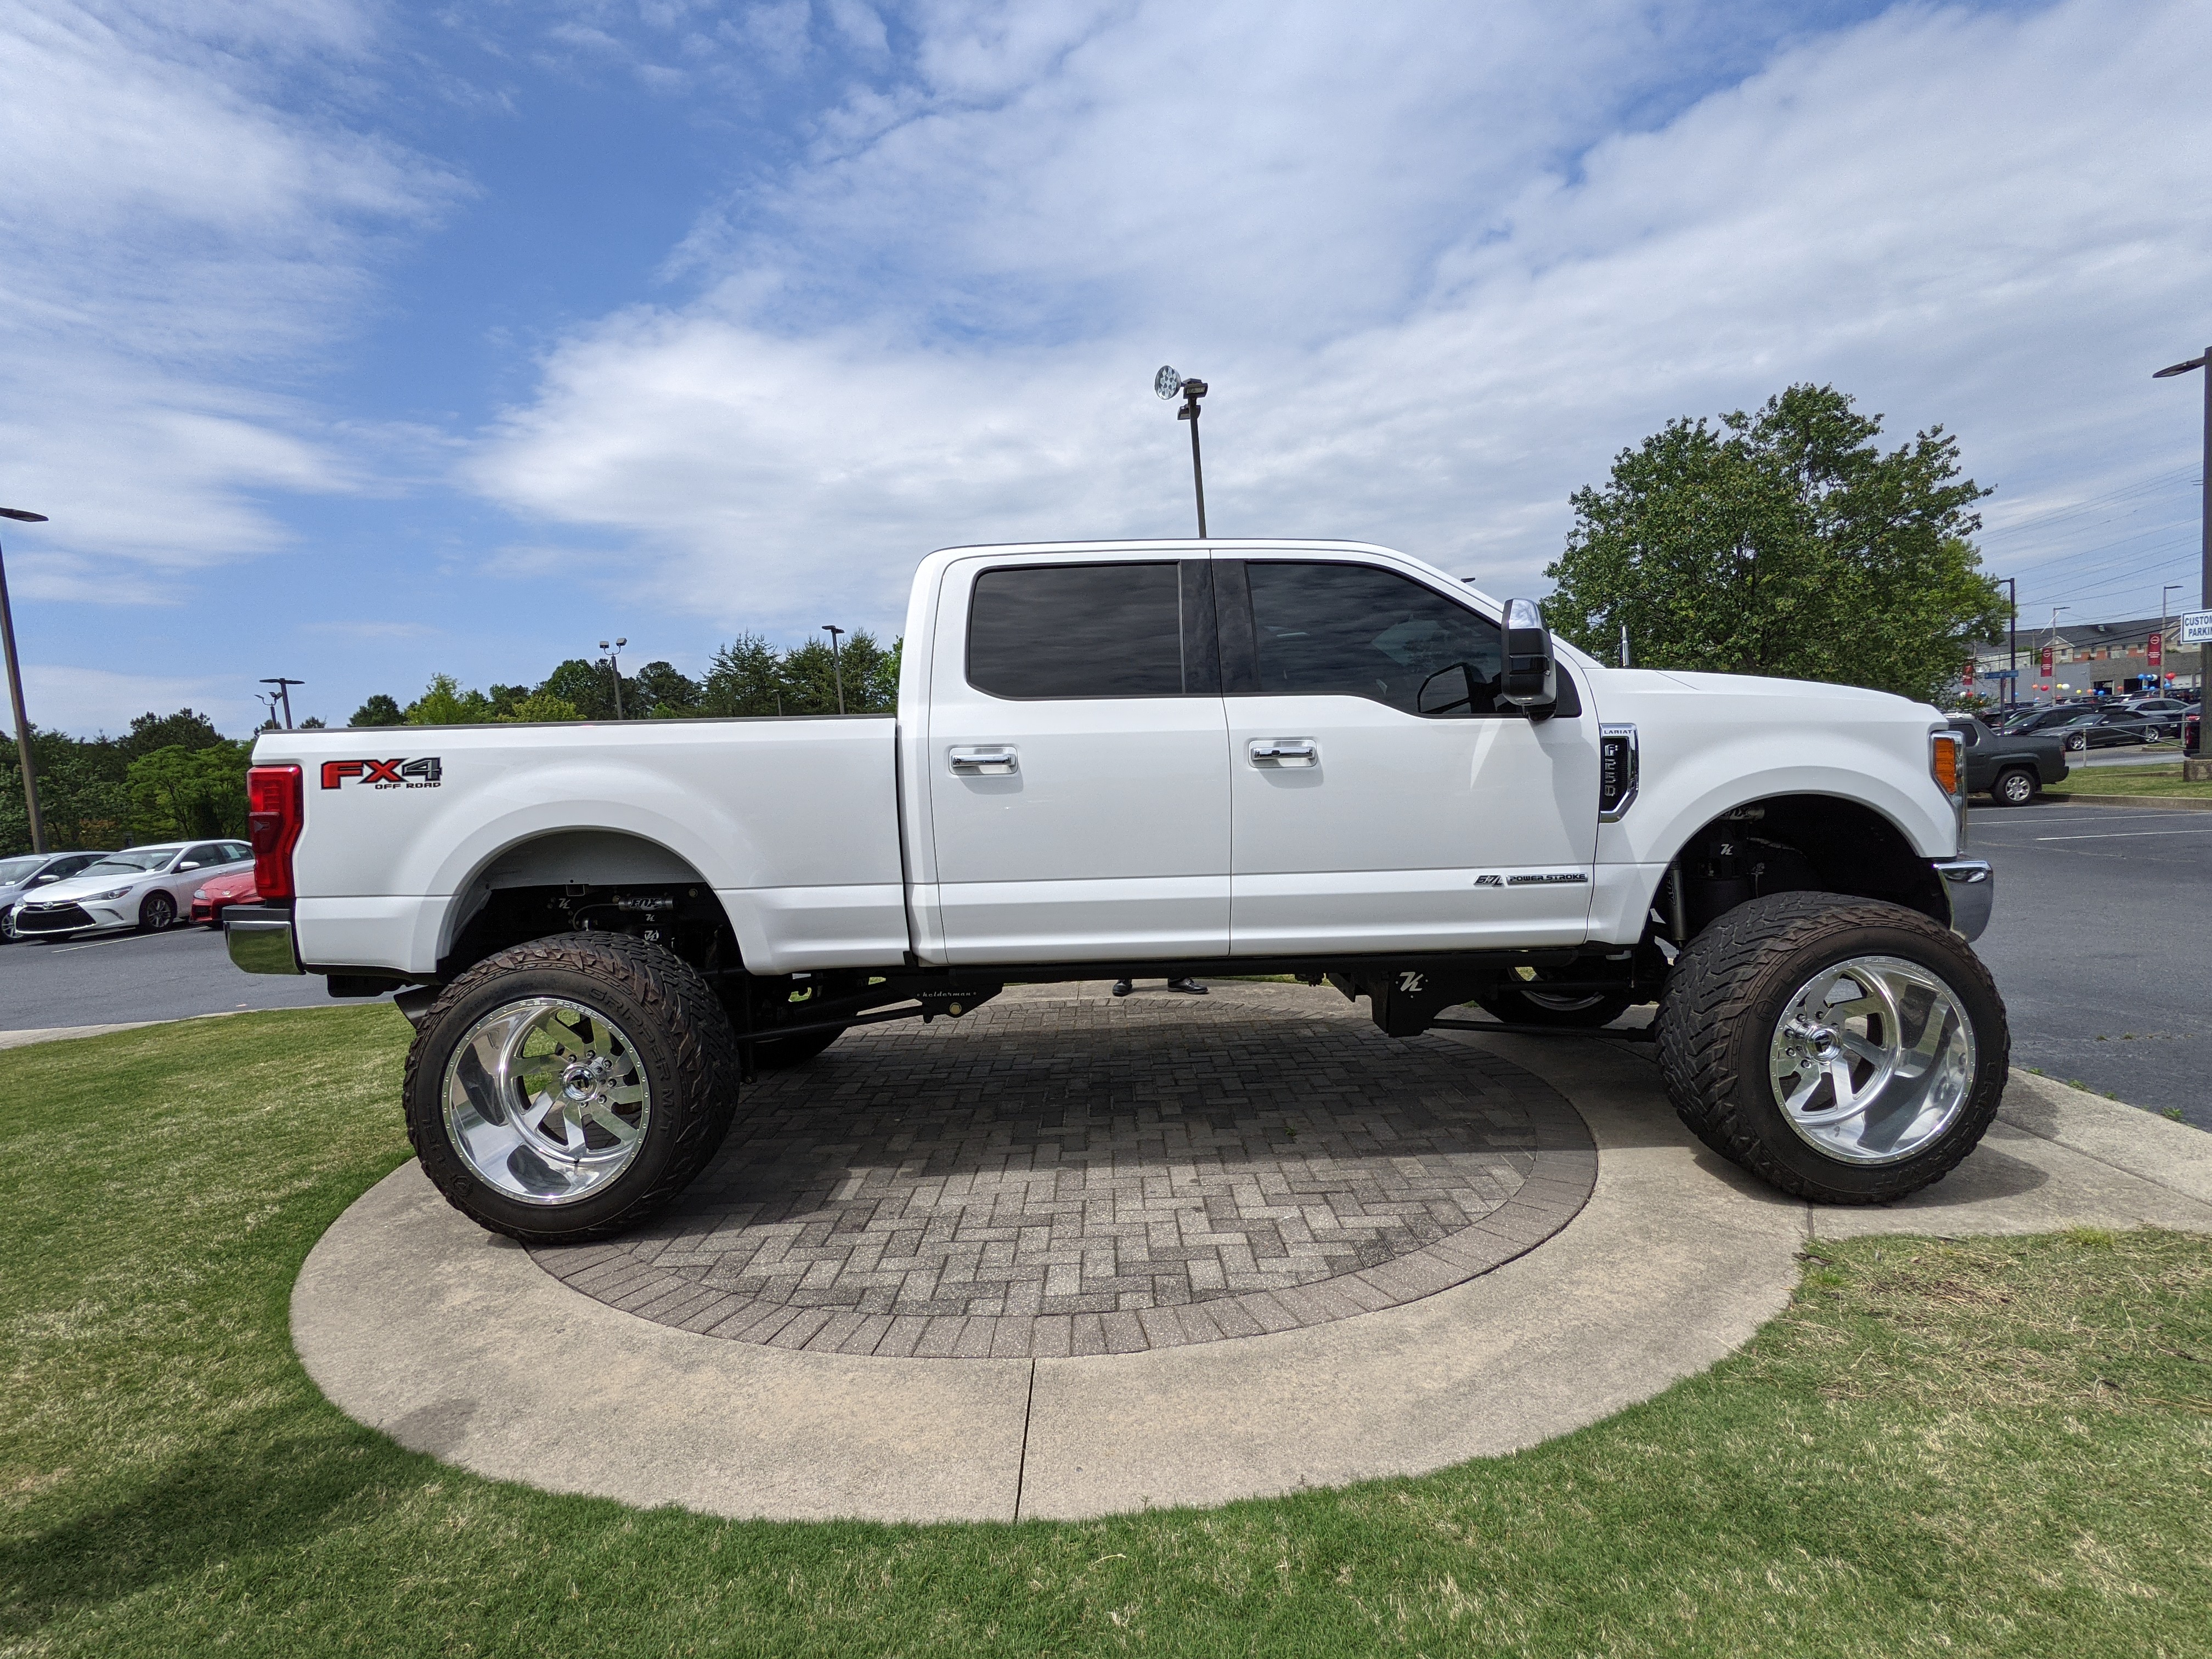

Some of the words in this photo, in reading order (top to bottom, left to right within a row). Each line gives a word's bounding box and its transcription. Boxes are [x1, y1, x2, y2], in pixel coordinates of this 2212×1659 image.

[321, 757, 443, 790] FX4
[630, 898, 662, 909] FOX
[1768, 949, 1832, 1002] FUEL
[590, 988, 670, 1081] GRIPPER
